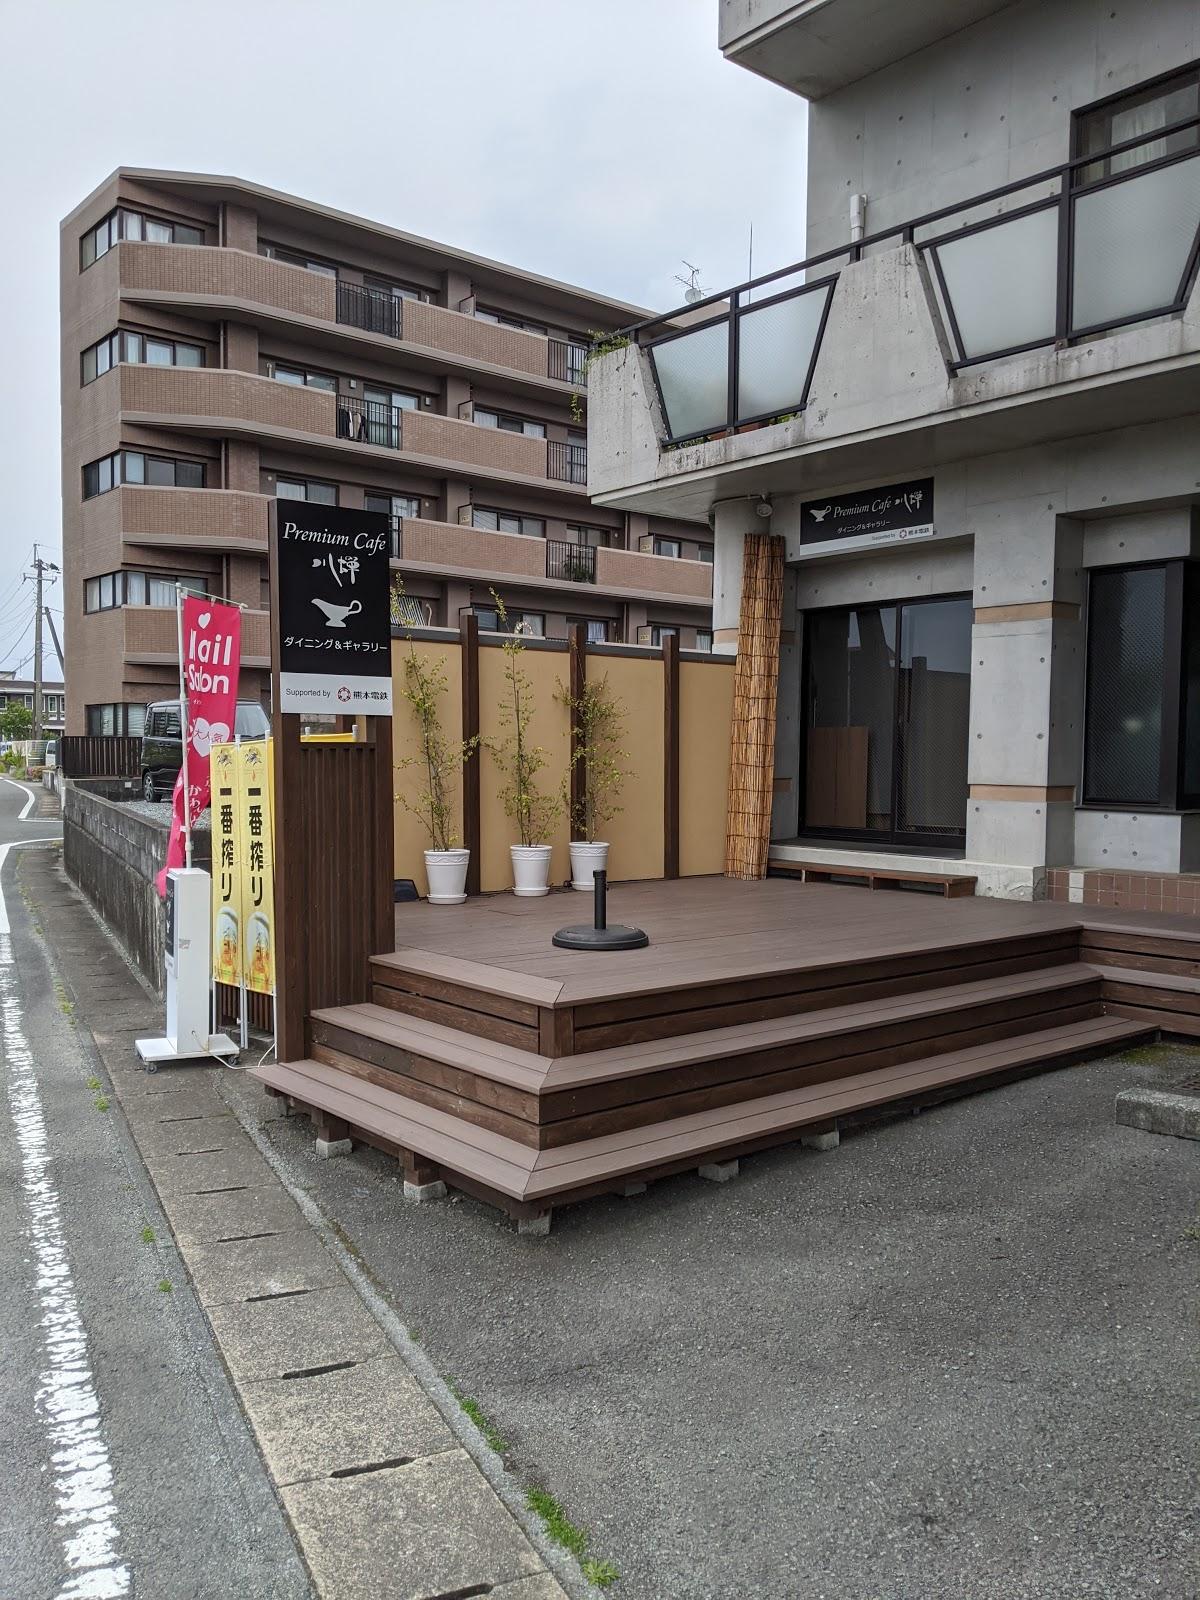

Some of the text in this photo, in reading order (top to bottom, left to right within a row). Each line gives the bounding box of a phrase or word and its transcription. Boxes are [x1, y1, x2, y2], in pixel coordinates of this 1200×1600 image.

[833, 496, 892, 519] Premium Cafe
[283, 522, 386, 557] Premium Cafe
[284, 636, 388, 652] ダイニング&ギャラリー
[285, 688, 331, 698] Supported by
[353, 691, 389, 701] 熊本電鉄
[219, 787, 234, 902] 一番搾り
[247, 787, 264, 907] 一番搾り
